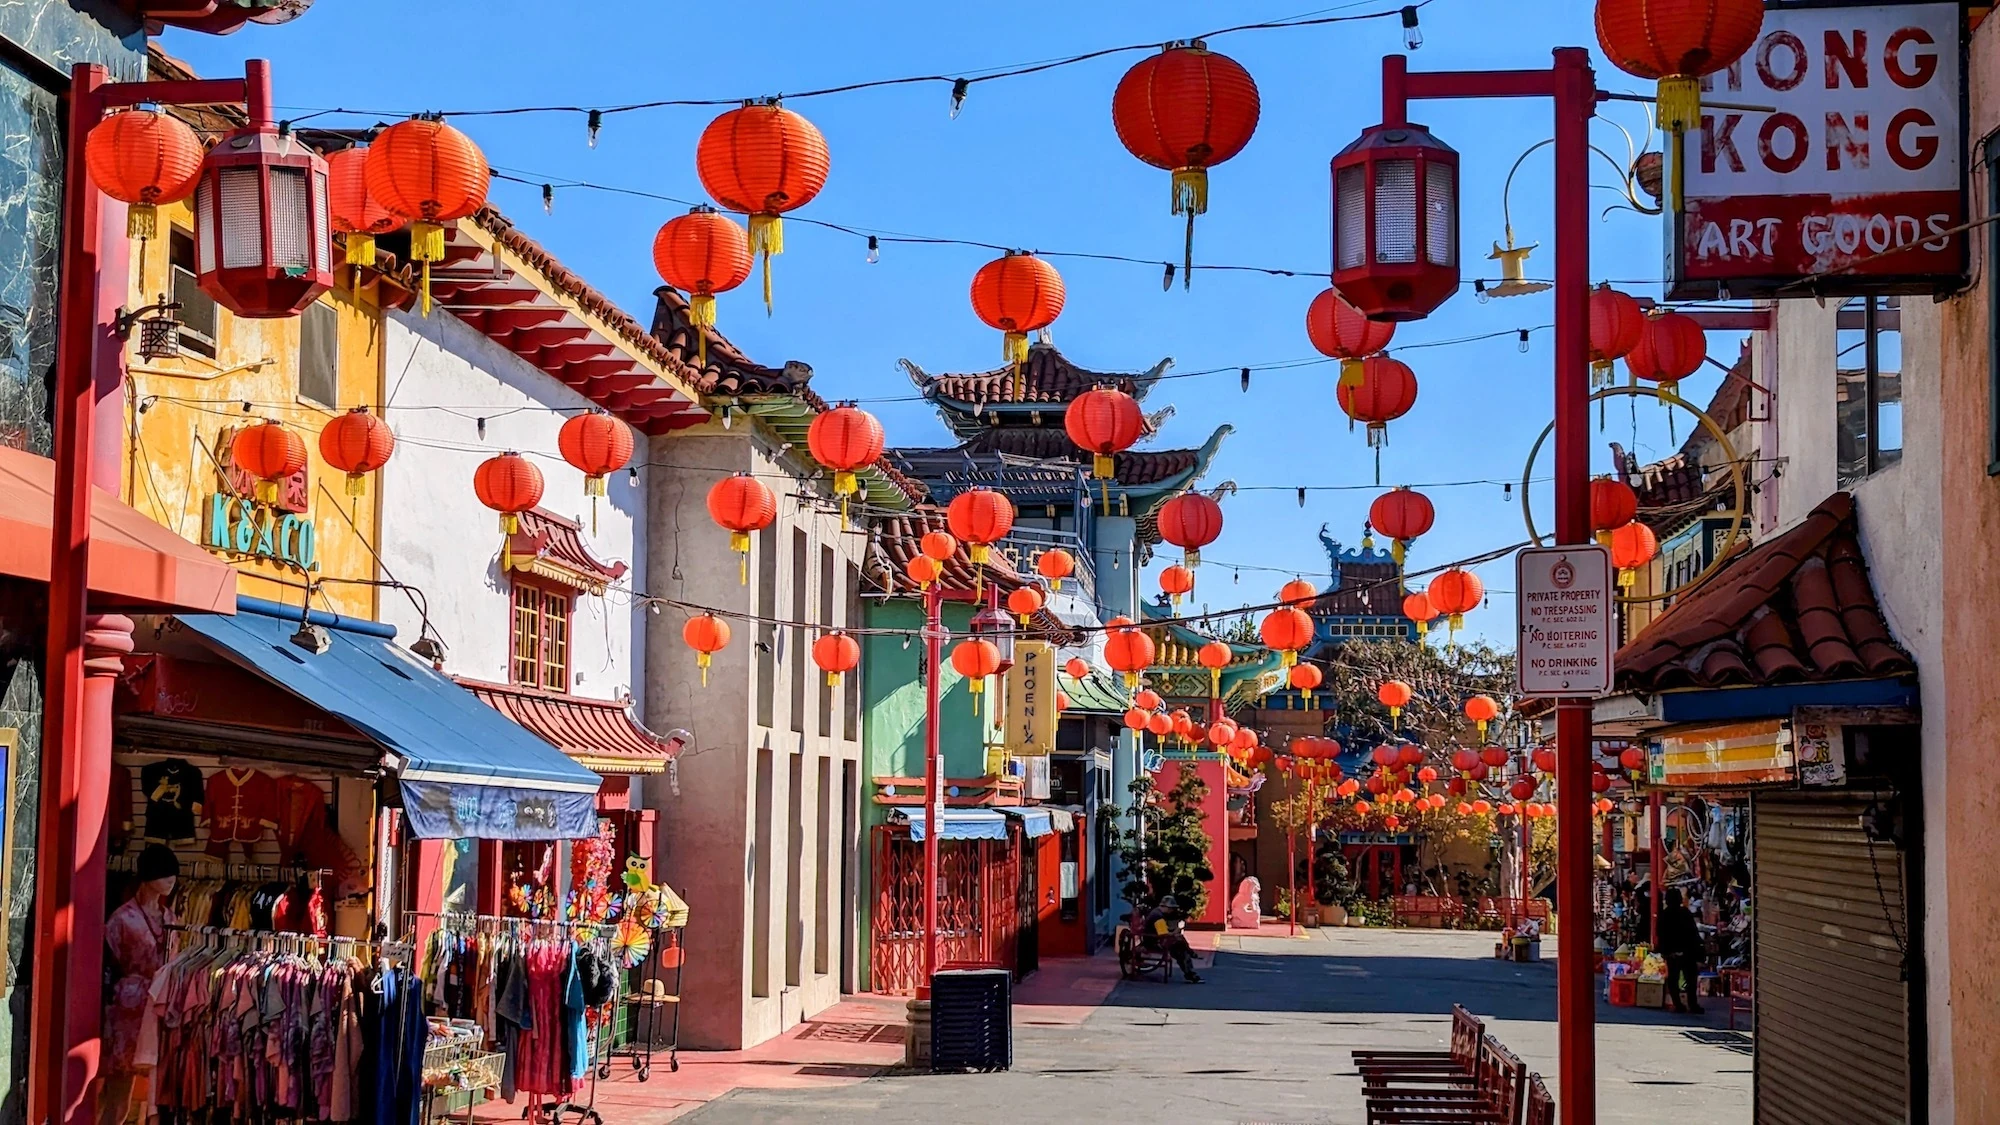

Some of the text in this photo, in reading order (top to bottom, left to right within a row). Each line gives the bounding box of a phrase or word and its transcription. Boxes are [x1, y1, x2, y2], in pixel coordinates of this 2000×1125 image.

[1701, 108, 1939, 173] KONG
[1698, 213, 1950, 256] ART GOODS
[1527, 589, 1601, 602] PRIVATE PROPERTY
[1531, 605, 1597, 616] NO TRESPASSING
[1531, 631, 1598, 641] NO LOITERING
[1531, 658, 1598, 668] NO DRINKING
[1024, 652, 1037, 744] PHOENIX
